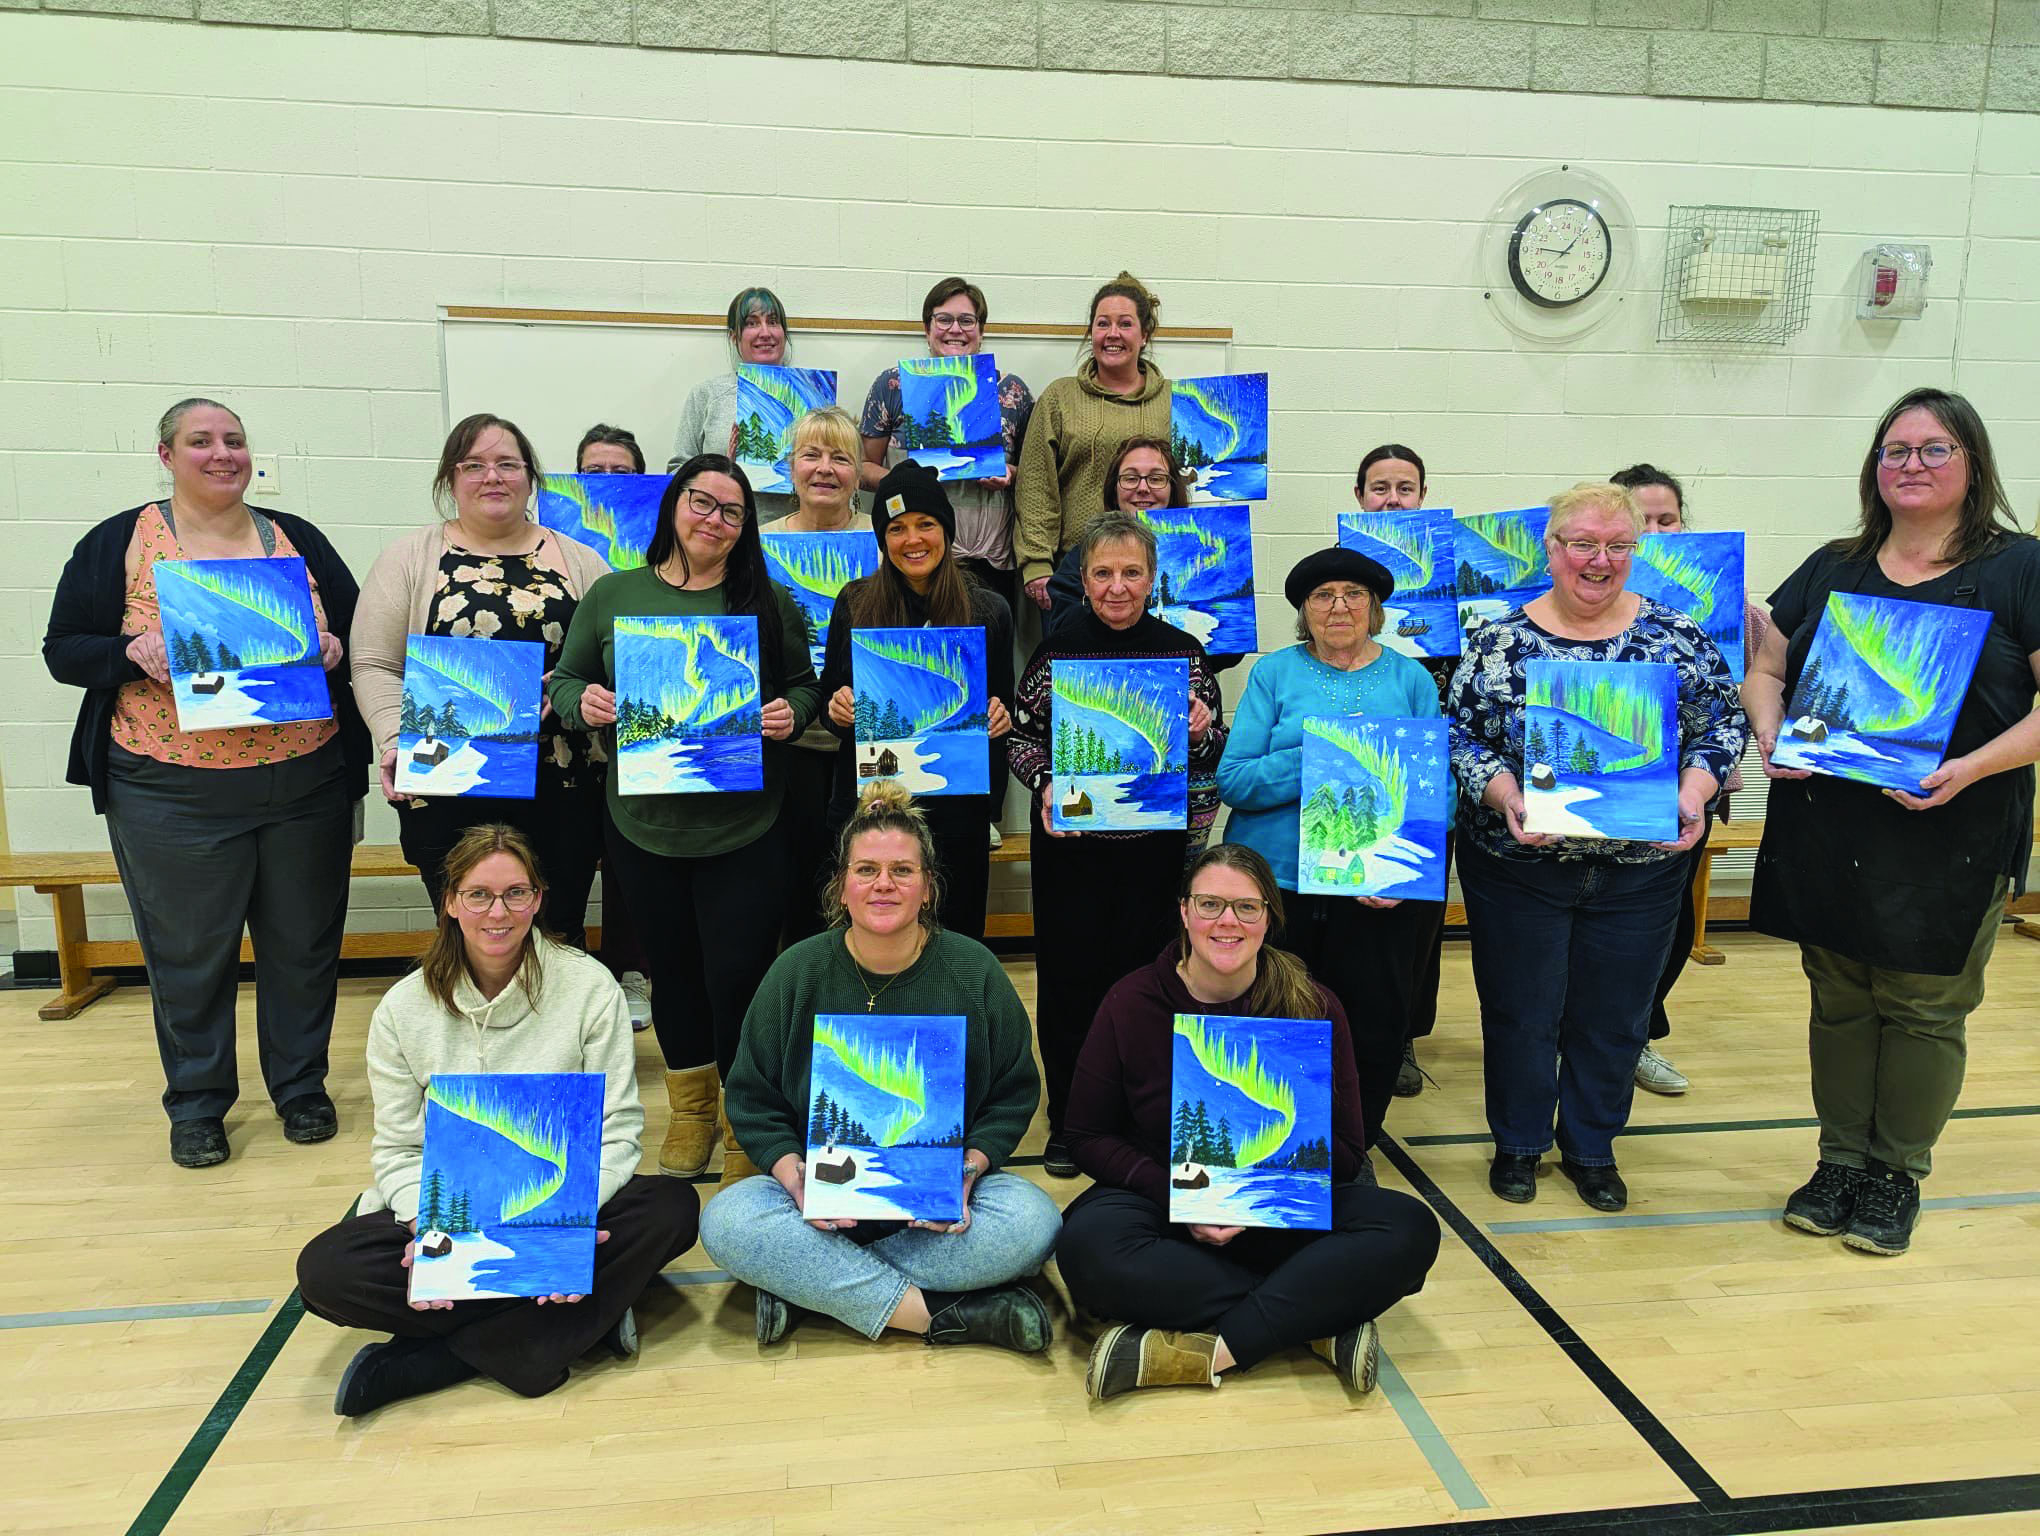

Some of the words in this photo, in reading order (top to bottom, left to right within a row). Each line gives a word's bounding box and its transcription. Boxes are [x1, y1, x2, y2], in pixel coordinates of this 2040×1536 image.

[1546, 210, 1552, 218] 11
[1595, 230, 1600, 238] 2
[1523, 246, 1528, 254] 9
[1598, 252, 1603, 260] 3
[1555, 291, 1560, 299] 6
[1575, 288, 1580, 296] 5
